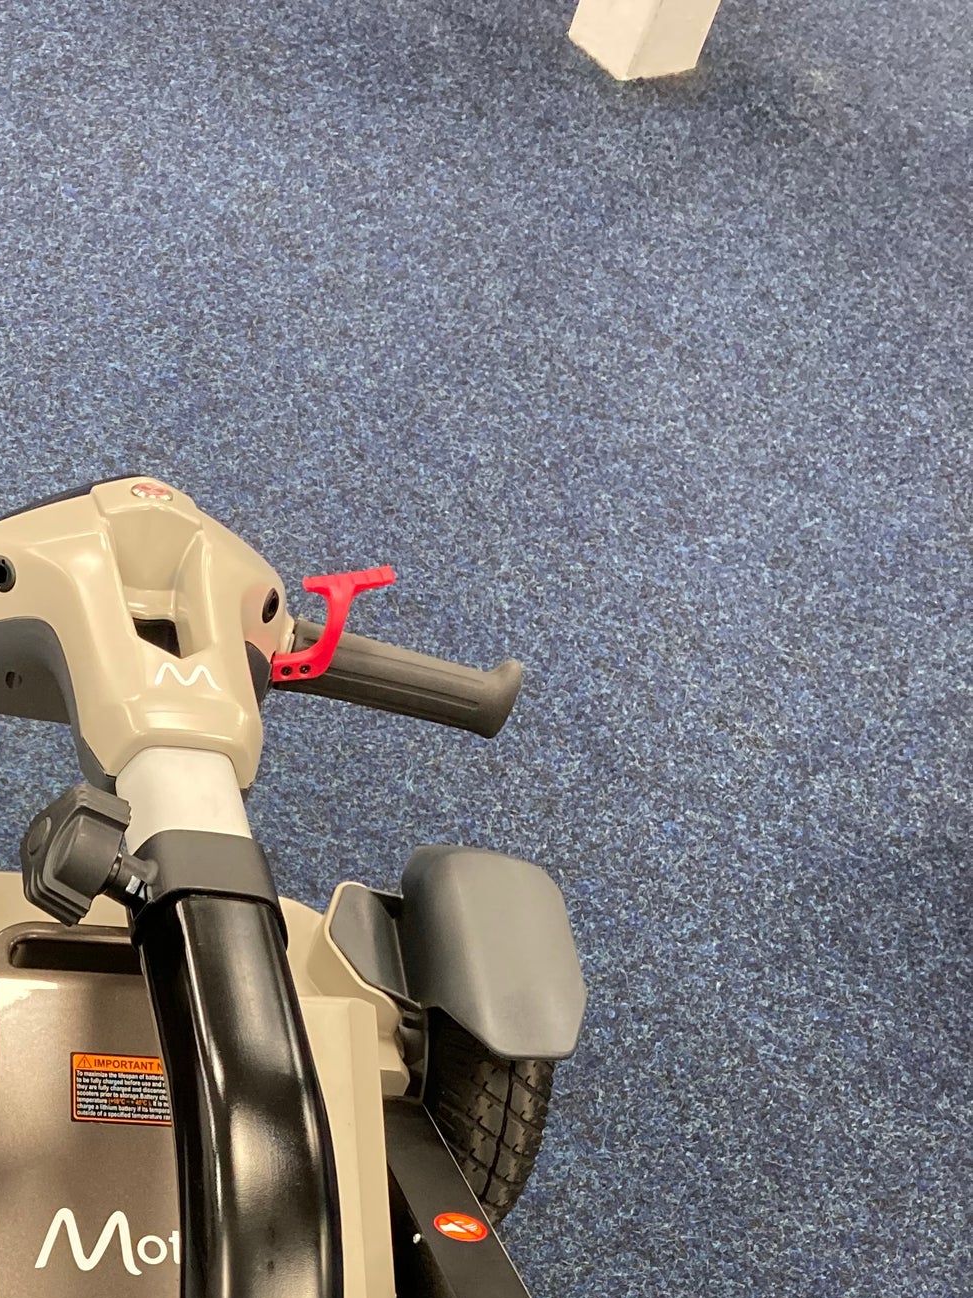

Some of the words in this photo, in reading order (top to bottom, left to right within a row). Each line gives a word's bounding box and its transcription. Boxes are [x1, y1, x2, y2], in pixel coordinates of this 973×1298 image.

[93, 1058, 154, 1071] IMPORTANT
[76, 1083, 87, 1091] they
[97, 1084, 109, 1092] fully
[90, 1077, 101, 1085] fully
[102, 1078, 123, 1087] charged
[34, 1207, 180, 1275] Mot
